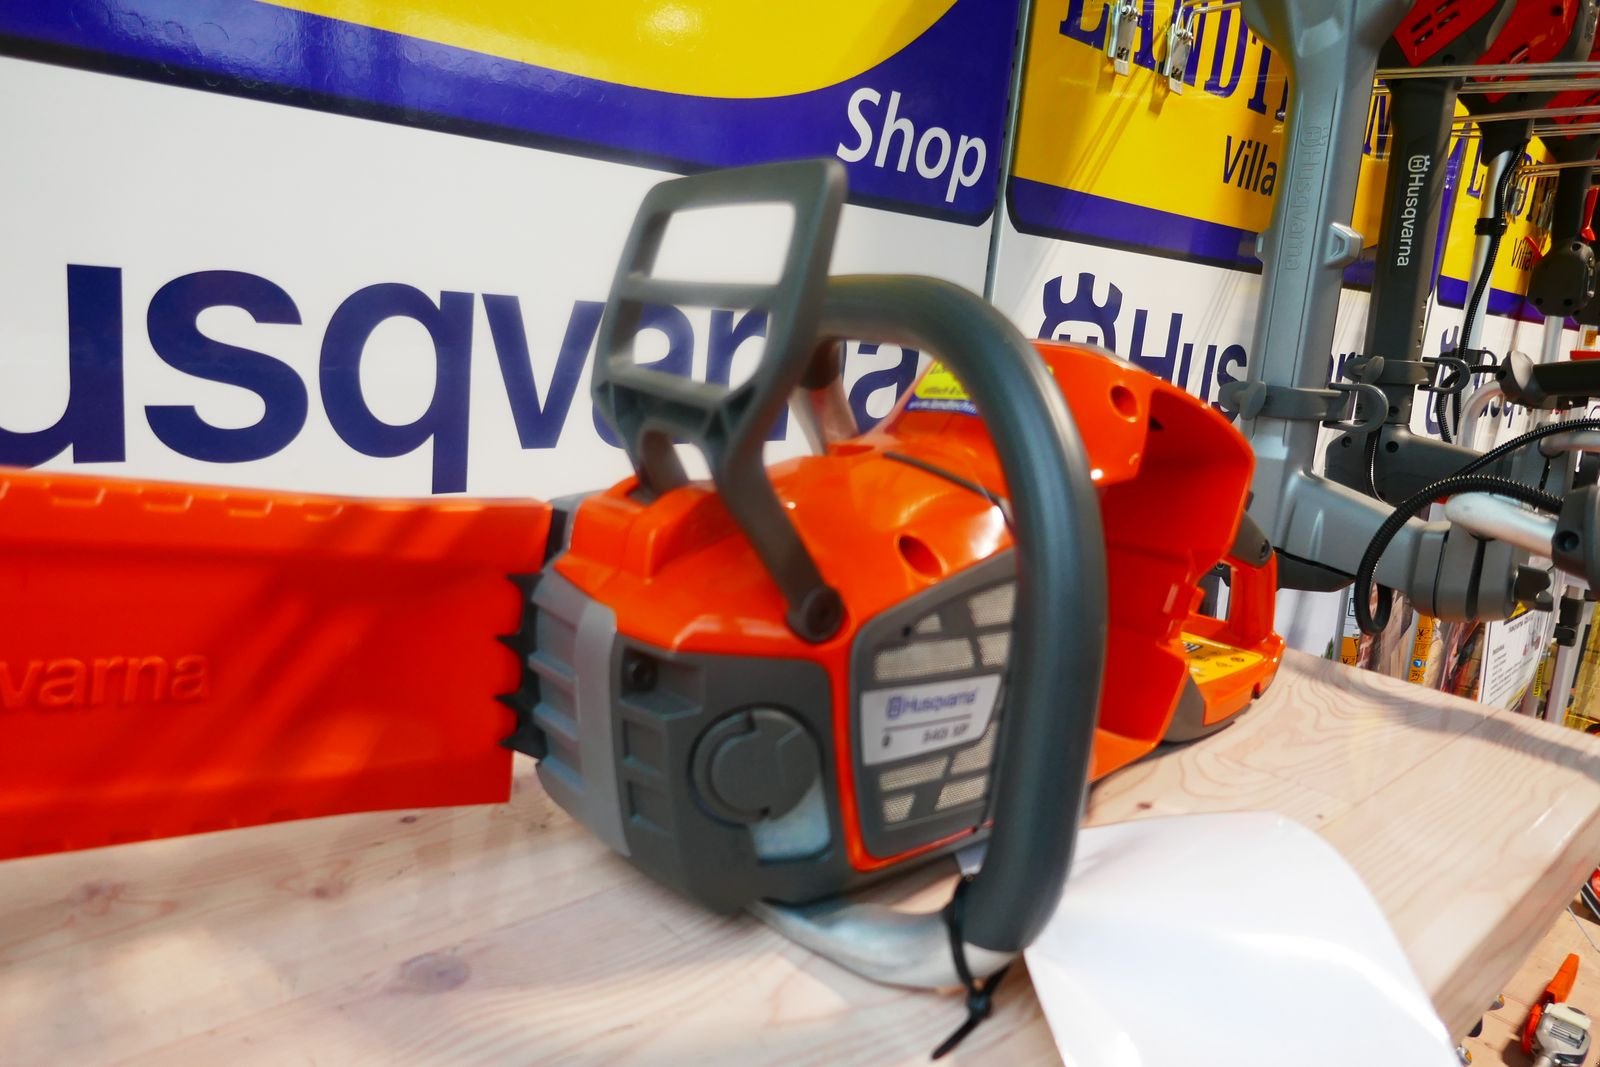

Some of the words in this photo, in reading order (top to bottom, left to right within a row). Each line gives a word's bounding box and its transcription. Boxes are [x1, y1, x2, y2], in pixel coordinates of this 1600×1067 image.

[836, 87, 987, 204] Shop
[1222, 134, 1278, 197] Villa
[1284, 148, 1321, 271] Husqvarna
[1396, 173, 1425, 267] Husqvarna
